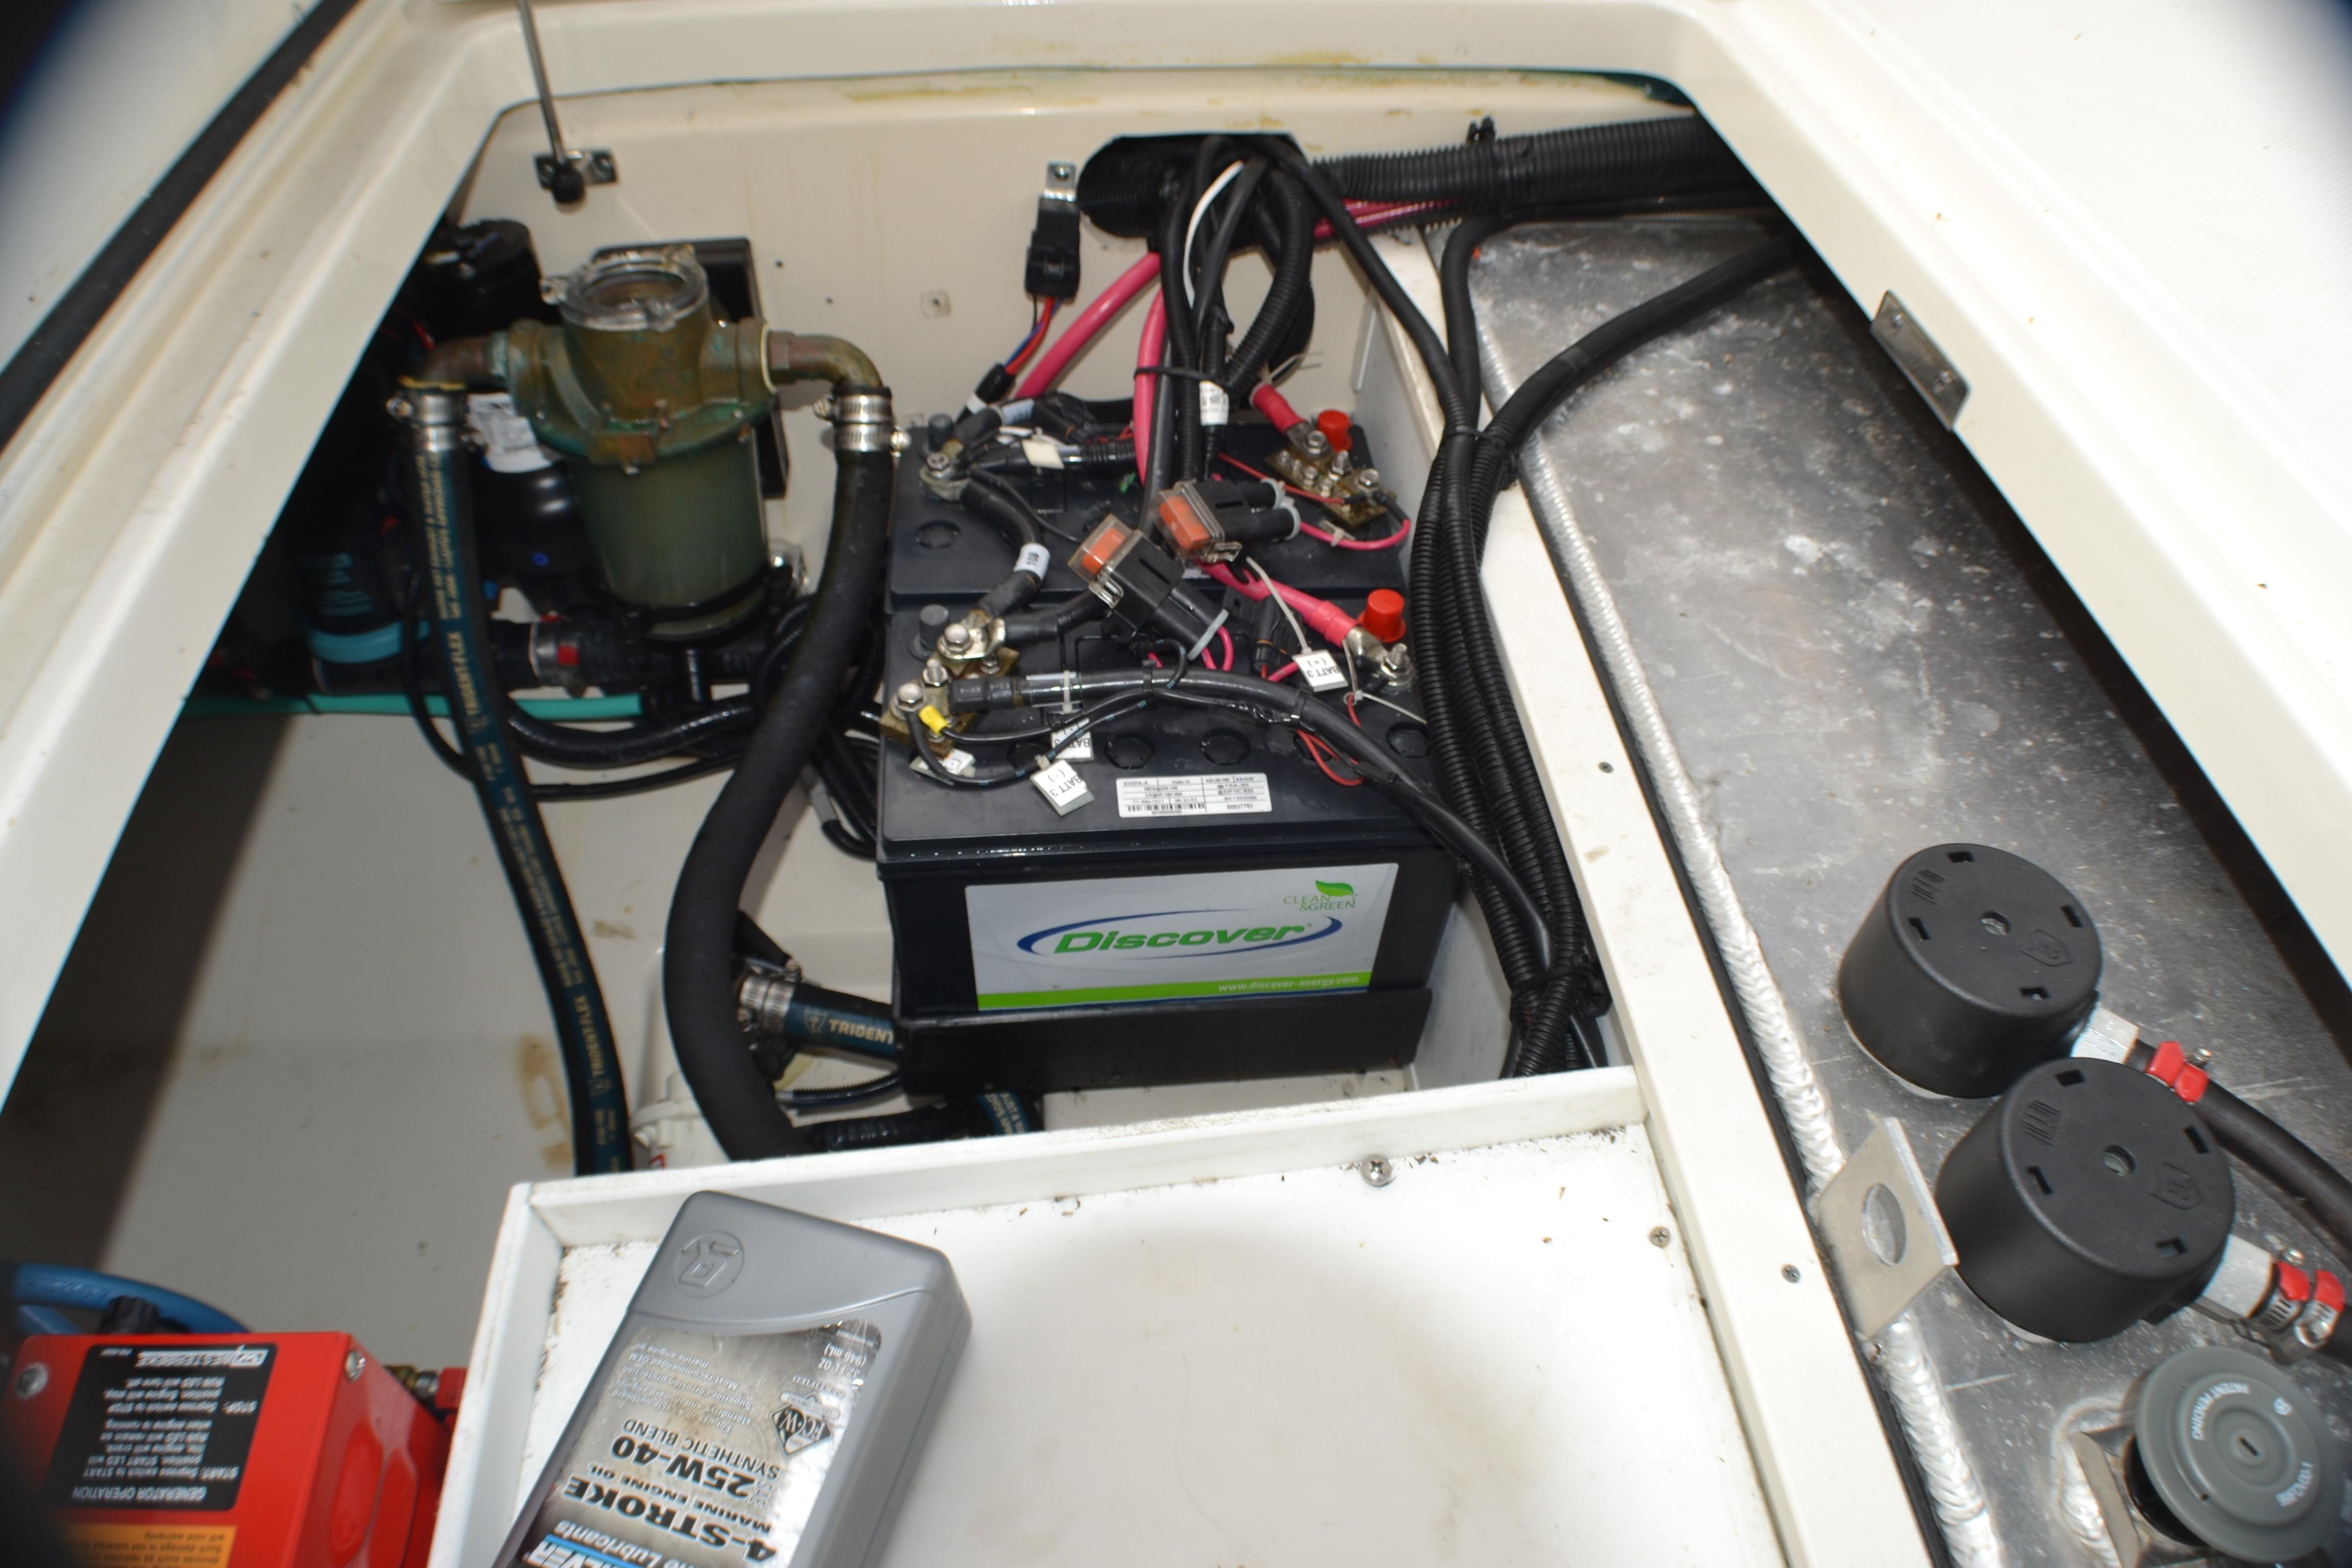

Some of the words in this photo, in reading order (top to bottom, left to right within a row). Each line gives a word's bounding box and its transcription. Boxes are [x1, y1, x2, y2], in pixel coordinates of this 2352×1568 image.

[1306, 670, 1314, 678] 3
[1315, 665, 1340, 677] BATT
[1057, 773, 1083, 793] BATT
[1048, 788, 1058, 798] 3
[1283, 895, 1330, 904] CLEAN
[1298, 900, 1355, 911] &GREEN
[1052, 922, 1305, 955] Discover
[1218, 975, 1359, 992] www.discover-energy.com
[646, 1343, 677, 1359] engine
[822, 1341, 844, 1360] mL)
[842, 1349, 867, 1368] (946
[650, 1356, 714, 1382] recommended
[676, 1353, 709, 1368] marine
[816, 1356, 832, 1371] OZ
[621, 1364, 669, 1383] protection
[714, 1375, 739, 1391] Most
[668, 1377, 710, 1396] corrosion
[712, 1390, 752, 1411] Superior
[623, 1417, 679, 1448] BLEND
[715, 1419, 732, 1433] For
[611, 1434, 757, 1500] 25W-40
[680, 1434, 781, 1481] SYNTHETIC
[83, 1466, 114, 1477] START
[72, 1486, 135, 1499] OPERATION
[135, 1486, 207, 1501] GENERATOR
[617, 1472, 689, 1508] ENGINE
[562, 1474, 776, 1564] 4-STROKE
[691, 1497, 772, 1536] MARINE
[552, 1516, 664, 1568] Lubricants
